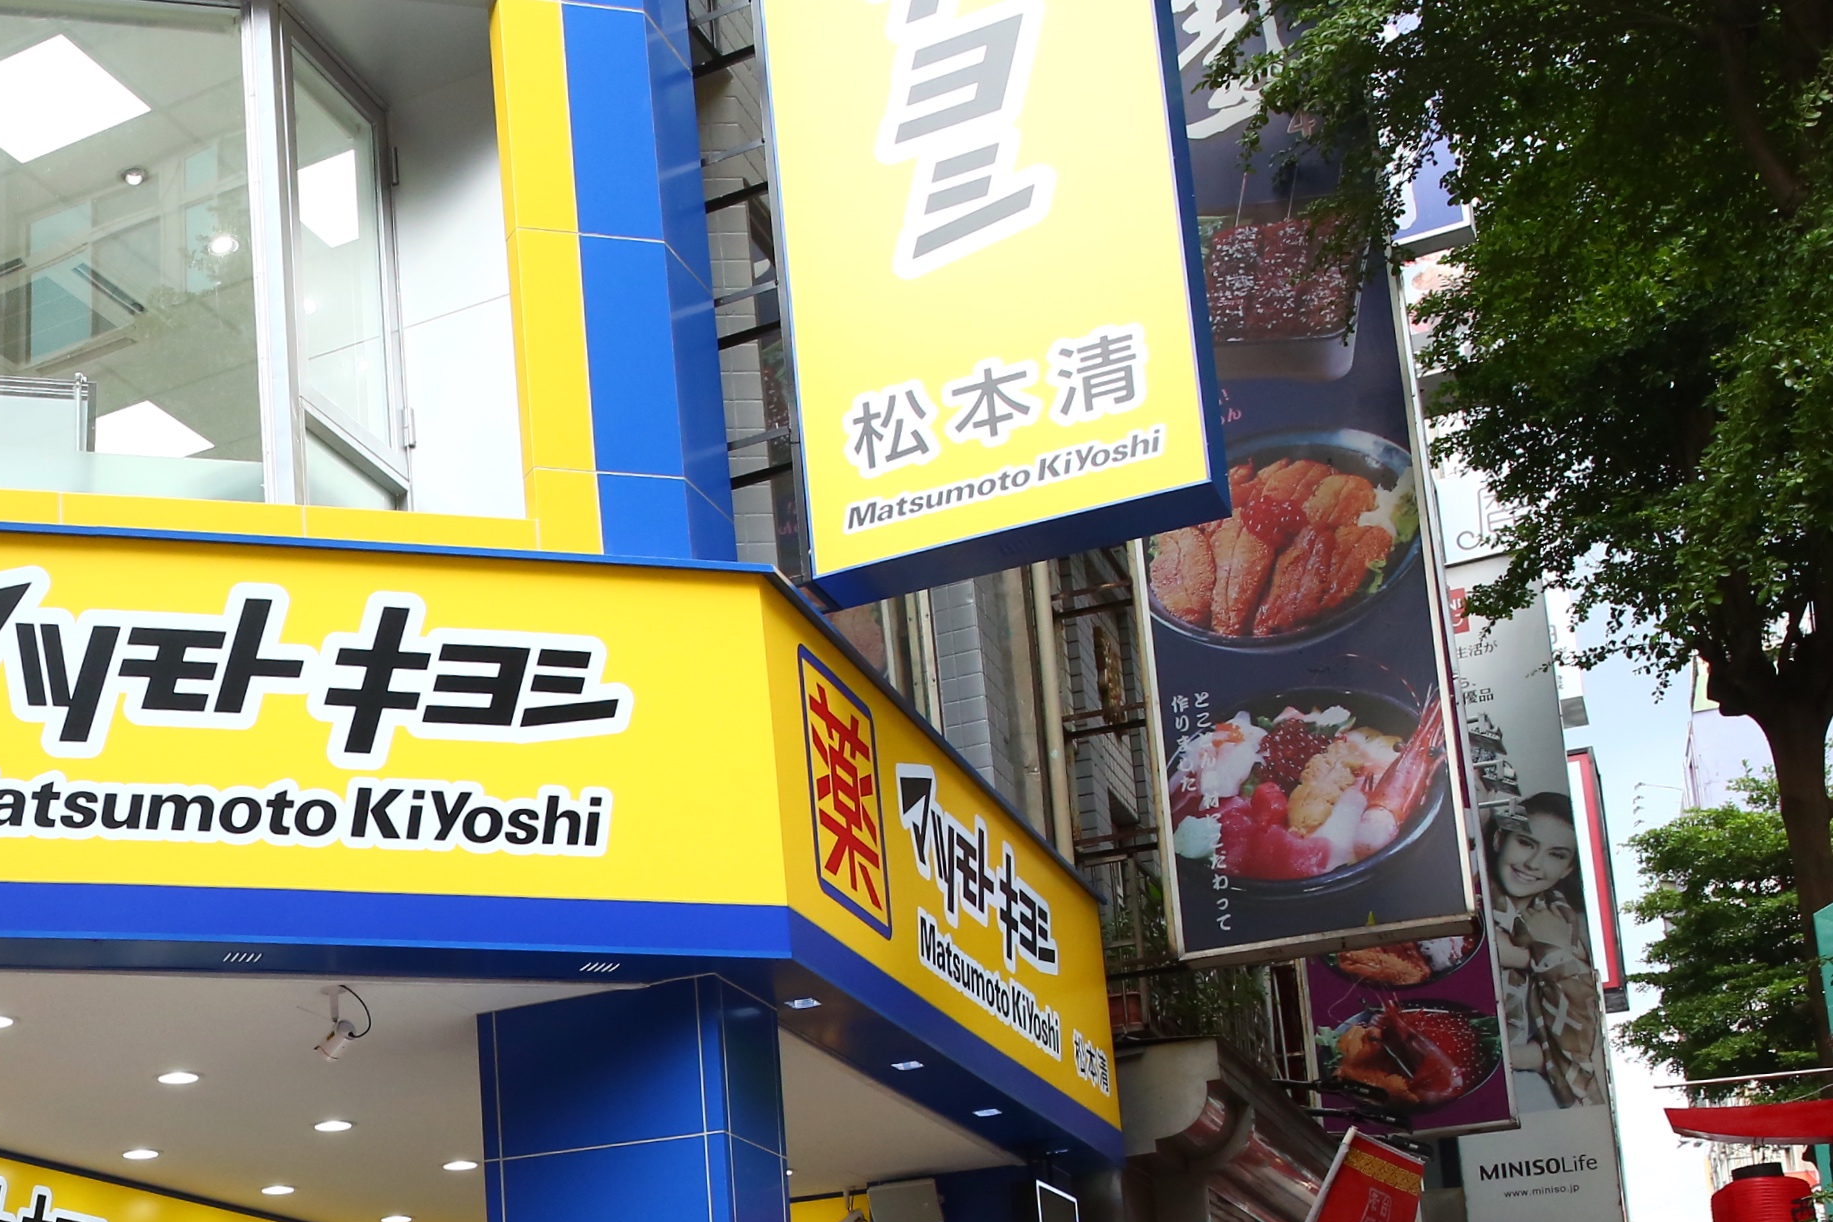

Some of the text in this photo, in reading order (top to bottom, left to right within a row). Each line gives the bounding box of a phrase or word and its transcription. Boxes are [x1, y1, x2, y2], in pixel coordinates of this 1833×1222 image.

[895, 0, 1035, 259] ヨシ
[852, 334, 1138, 470] 松本清
[847, 429, 1161, 530] Matsumoto KiYoshi
[809, 683, 882, 911] 薬
[1171, 694, 1197, 793] 作りました
[351, 787, 602, 847] KiYoshi
[899, 778, 1056, 963] マツモトキヨシ
[920, 917, 1061, 1055] Matsumoto KiYoshi
[1074, 1035, 1110, 1093] 松本清
[1504, 1183, 1580, 1198] www.miniso.jp
